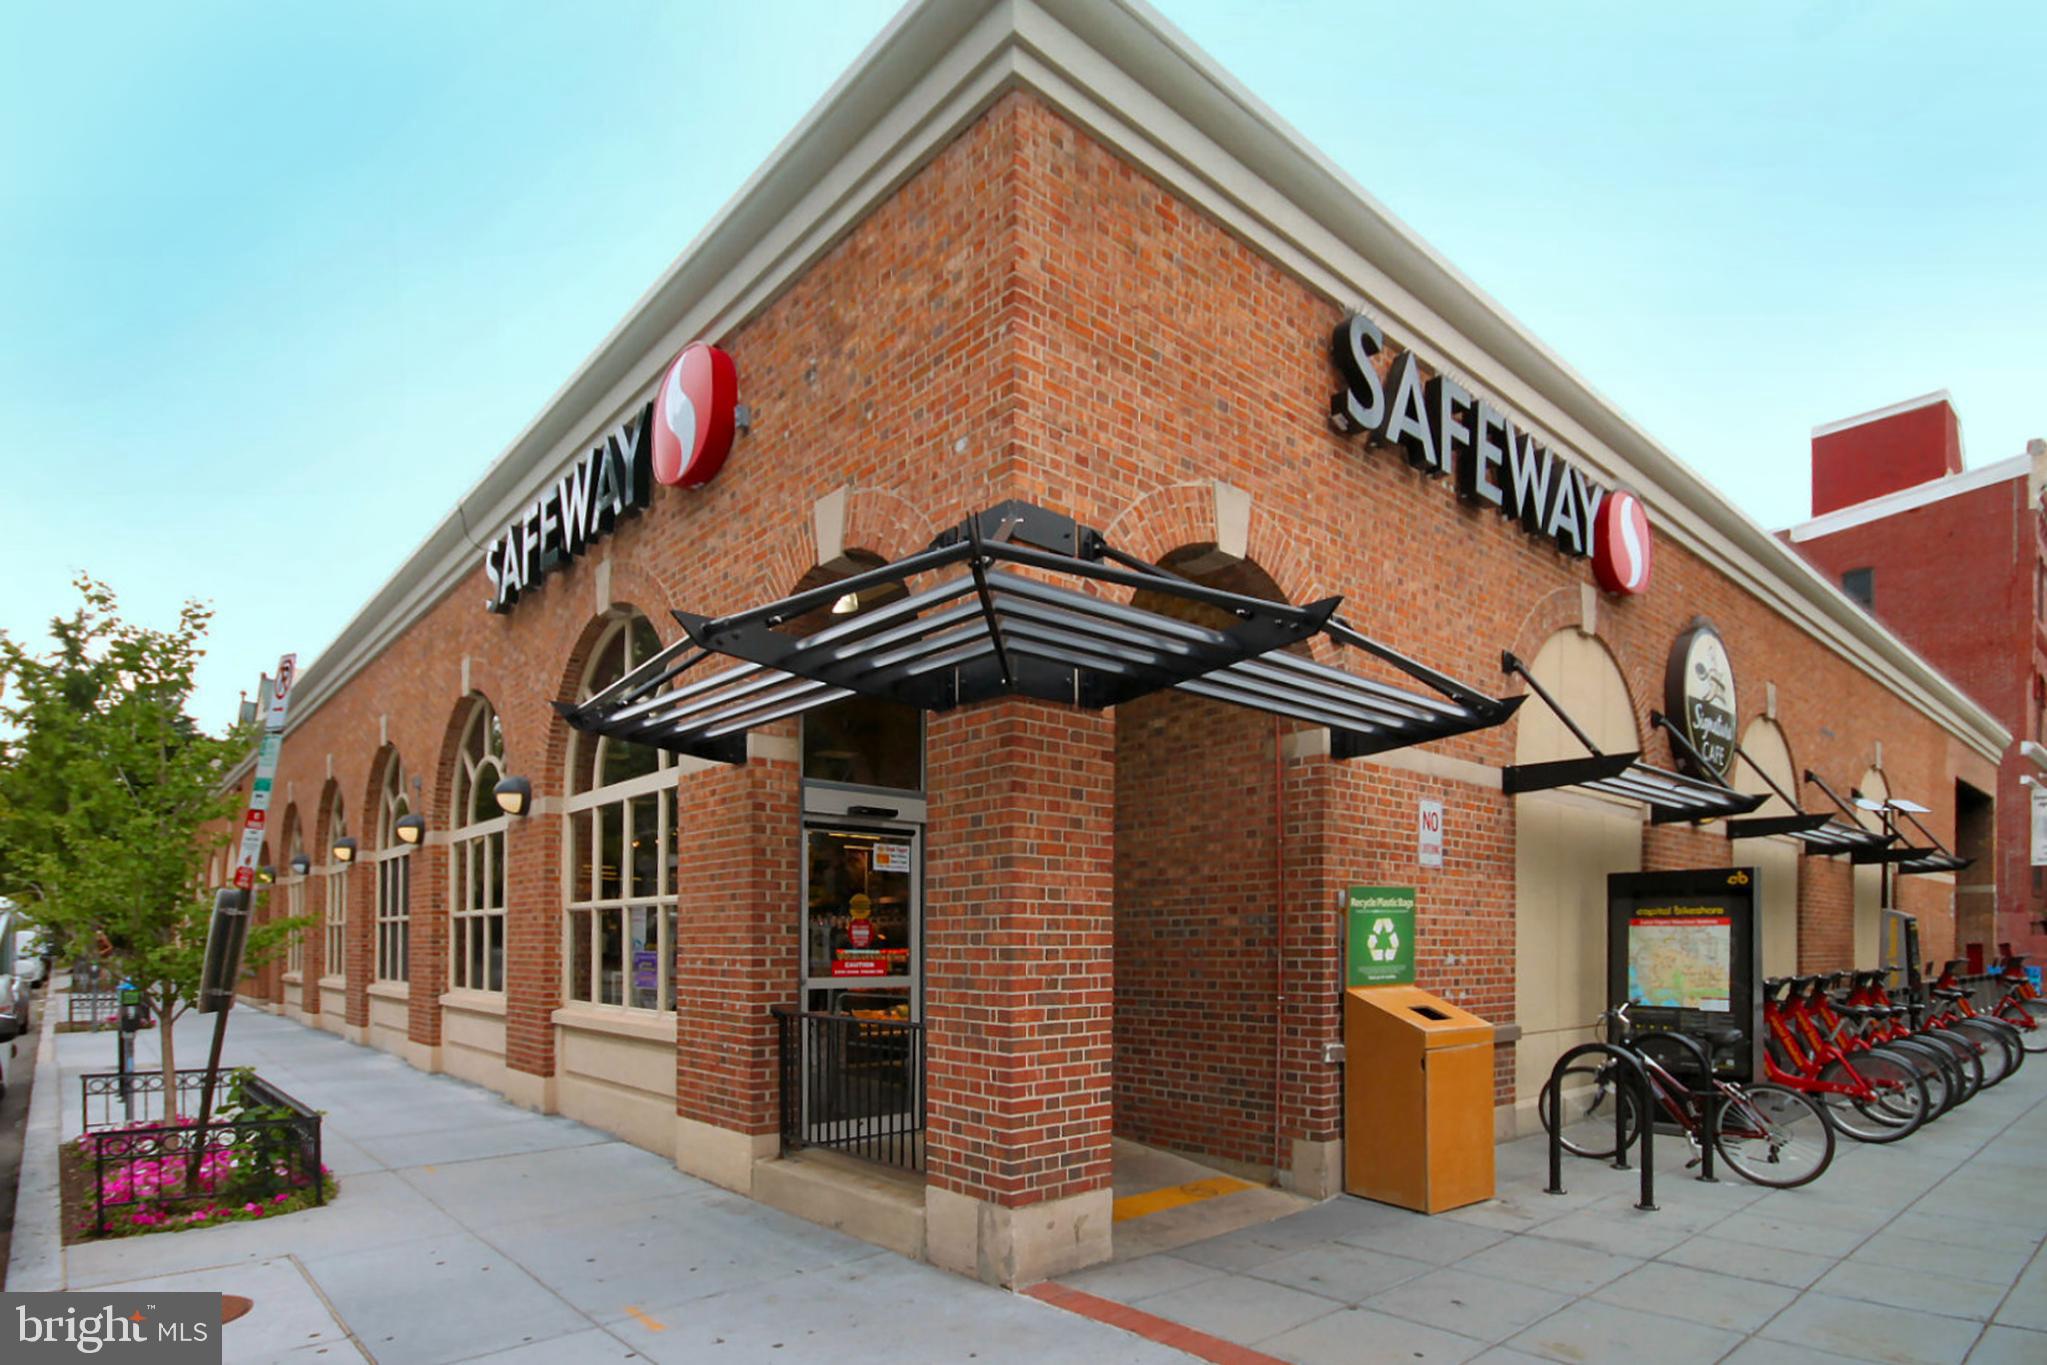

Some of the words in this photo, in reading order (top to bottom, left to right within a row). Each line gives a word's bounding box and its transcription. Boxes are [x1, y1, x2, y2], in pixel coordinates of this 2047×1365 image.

[1332, 313, 1605, 558] SAFEWAY
[484, 402, 653, 614] SAFEWAY
[1422, 811, 1439, 833] NO
[1350, 897, 1375, 910] Recycle
[1375, 897, 1399, 908] Plastic
[1398, 898, 1414, 910] Bags
